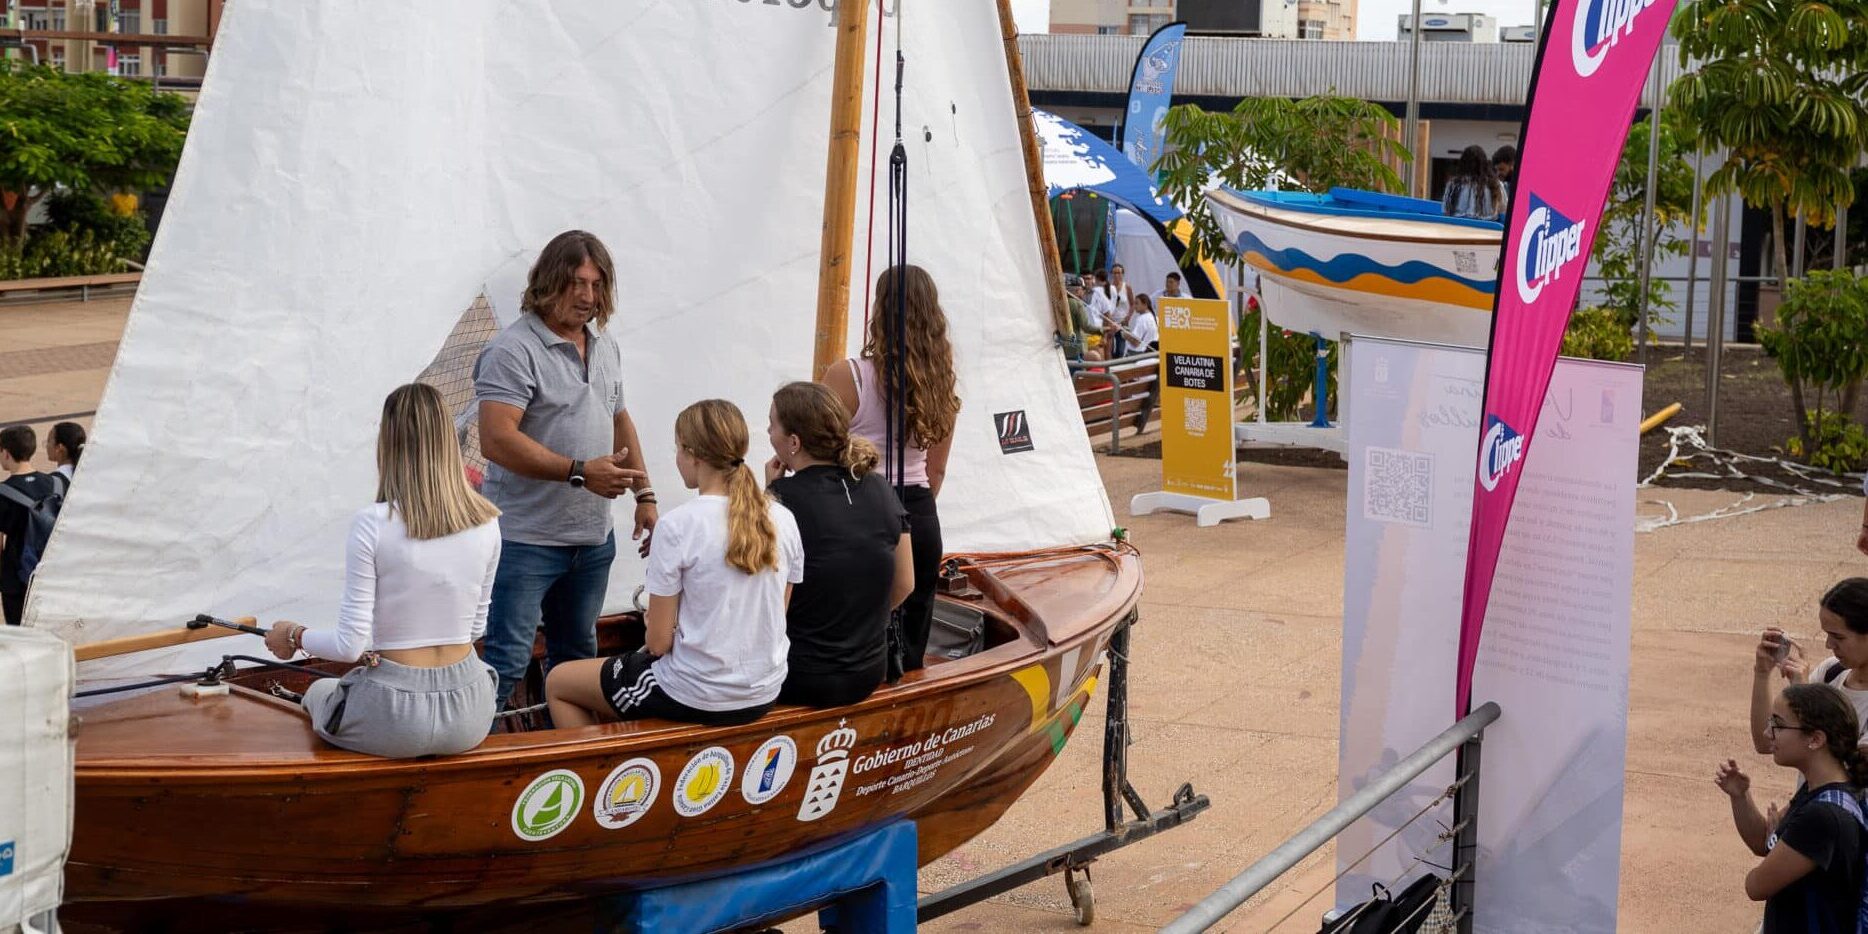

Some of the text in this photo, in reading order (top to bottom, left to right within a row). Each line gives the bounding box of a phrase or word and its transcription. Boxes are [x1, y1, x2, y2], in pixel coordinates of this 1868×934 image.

[1517, 206, 1586, 304] Clipper
[1164, 306, 1190, 317] EXPO
[1174, 355, 1215, 367] VELA LATINA
[1174, 366, 1215, 378] CANARIA DE
[1183, 377, 1206, 388] BOTES
[852, 713, 996, 774] Gobierno de Canarias
[904, 748, 945, 770] IDENTIDAD
[856, 779, 887, 797] Deporte
